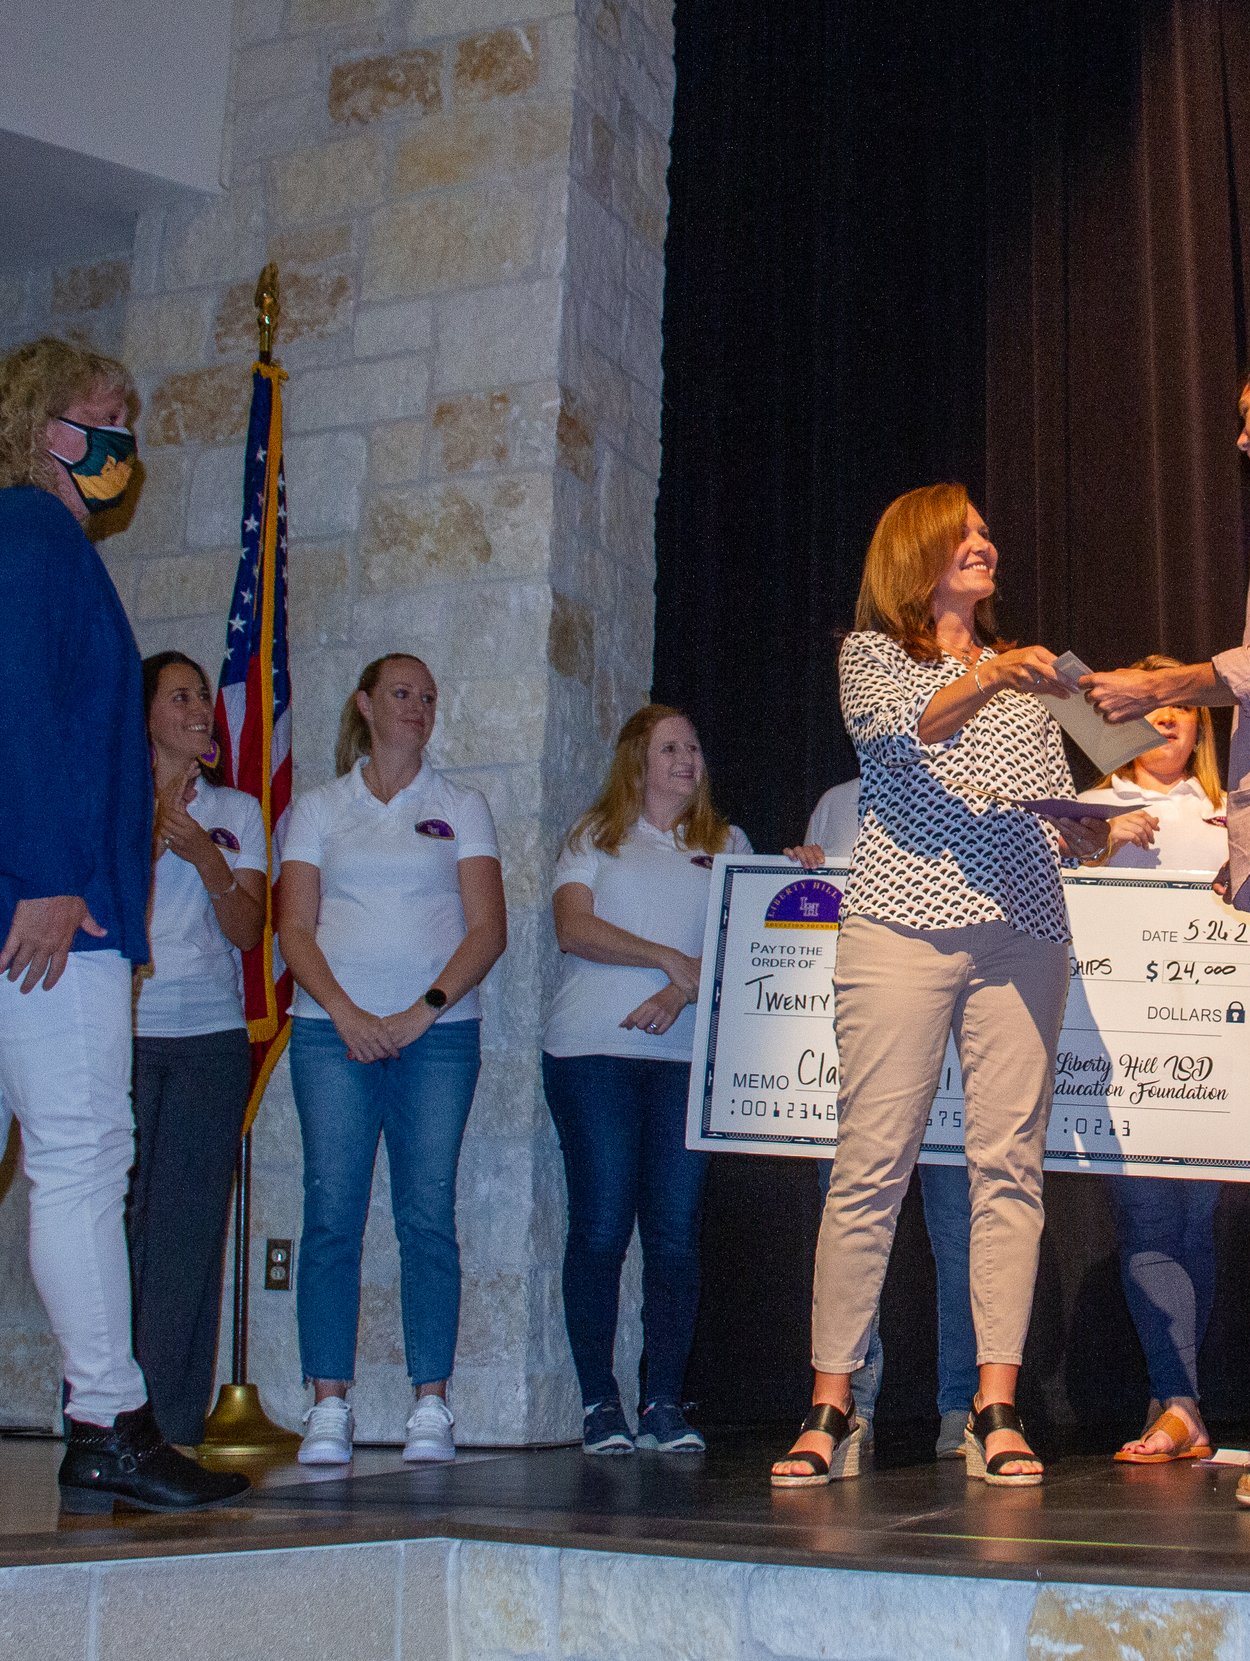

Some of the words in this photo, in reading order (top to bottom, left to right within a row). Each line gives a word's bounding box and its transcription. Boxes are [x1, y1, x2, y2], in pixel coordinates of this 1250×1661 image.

[768, 882, 806, 918] LIBERTY
[813, 882, 838, 899] HILL
[1142, 930, 1178, 943] DATE
[750, 942, 777, 954] PAY
[780, 945, 796, 955] TO
[799, 946, 823, 956] THE
[751, 957, 796, 968] ORDER
[798, 959, 817, 969] OF
[1069, 957, 1112, 976] SHIPS
[1147, 1006, 1222, 1023] DOLLARS
[797, 1049, 837, 1088] Cla
[1056, 1052, 1112, 1080] Liberty
[1119, 1053, 1159, 1081] Hill
[1164, 1055, 1213, 1082] ISD
[733, 1073, 790, 1090] MEMO
[1053, 1079, 1125, 1097] ducation
[1130, 1079, 1229, 1104] Foundation
